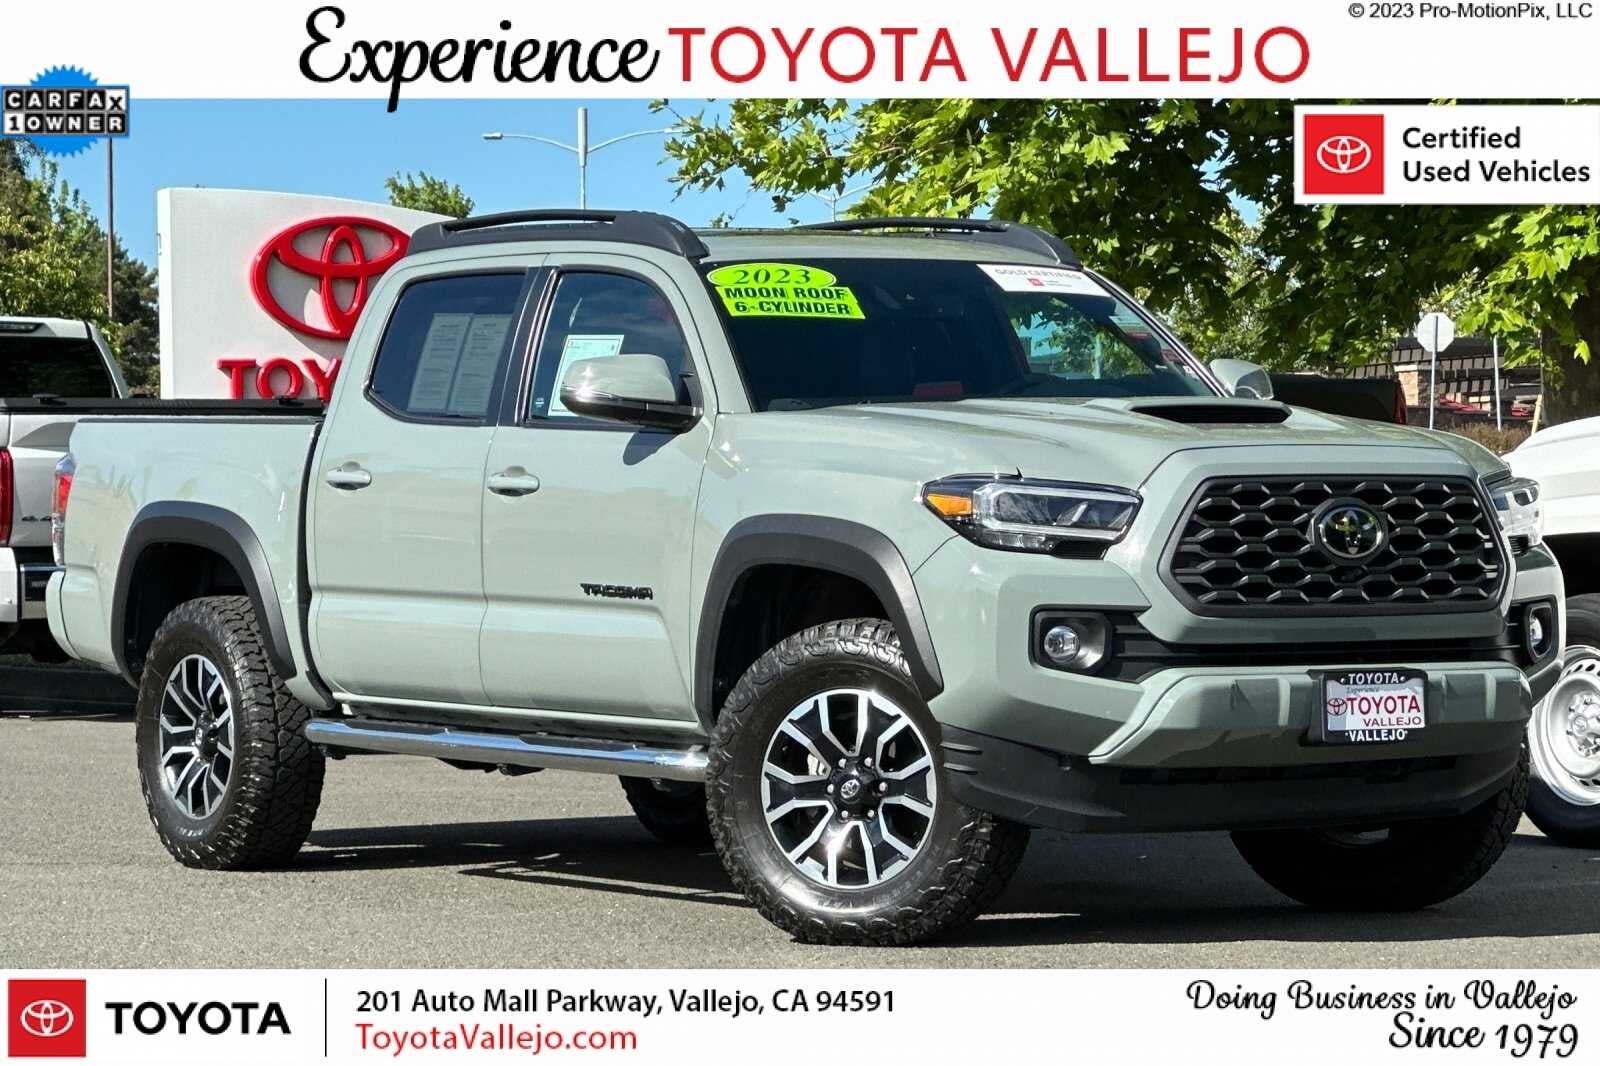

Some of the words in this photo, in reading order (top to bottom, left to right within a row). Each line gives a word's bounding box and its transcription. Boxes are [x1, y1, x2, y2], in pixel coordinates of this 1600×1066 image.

[733, 269, 811, 285] 2023
[724, 287, 786, 299] MOON
[793, 287, 847, 299] ROOF
[734, 301, 850, 315] 6-CYLINDER
[580, 583, 653, 600] TACOMA
[1348, 672, 1399, 684] TOYOTA
[1346, 694, 1421, 715] TOYOTA
[1362, 716, 1422, 727] VALLEJO
[1349, 728, 1406, 742] VALLEJO
